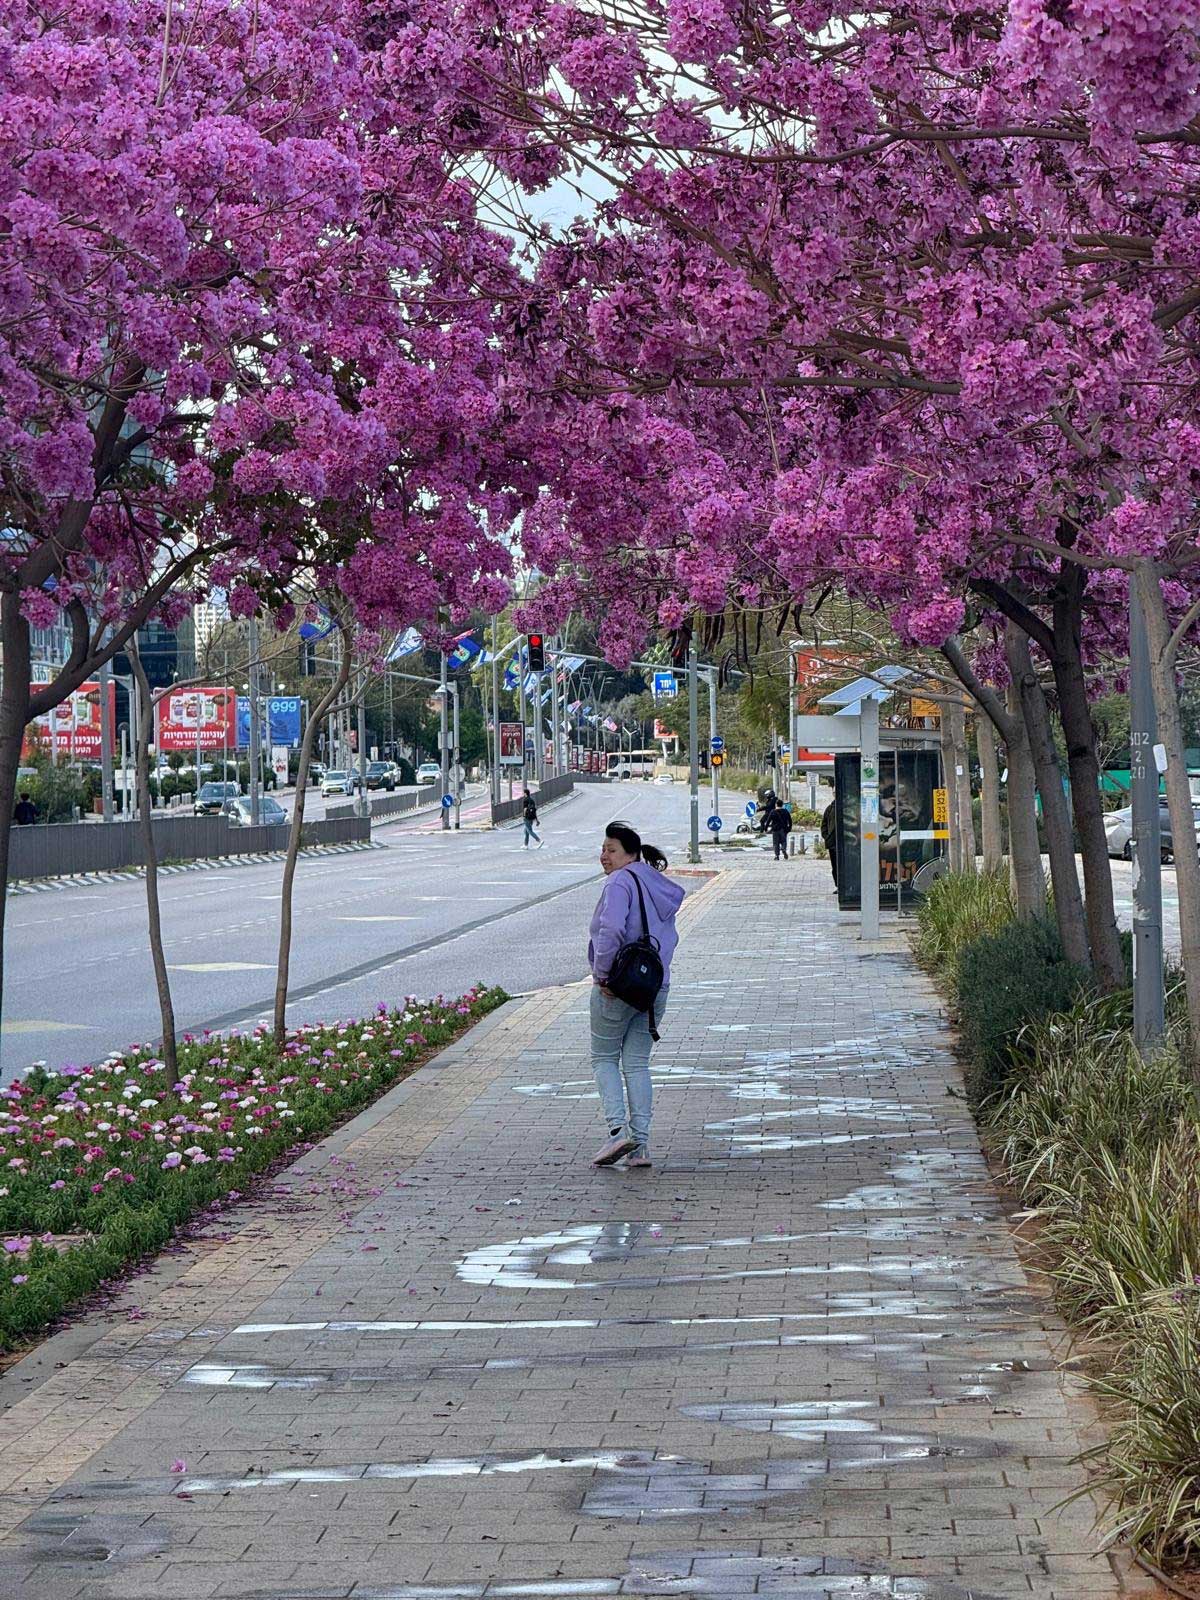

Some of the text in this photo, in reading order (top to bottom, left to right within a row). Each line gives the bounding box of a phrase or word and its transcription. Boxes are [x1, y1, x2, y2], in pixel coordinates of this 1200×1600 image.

[271, 701, 297, 713] egg
[1135, 750, 1142, 762] 2
[1131, 766, 1146, 779] 20
